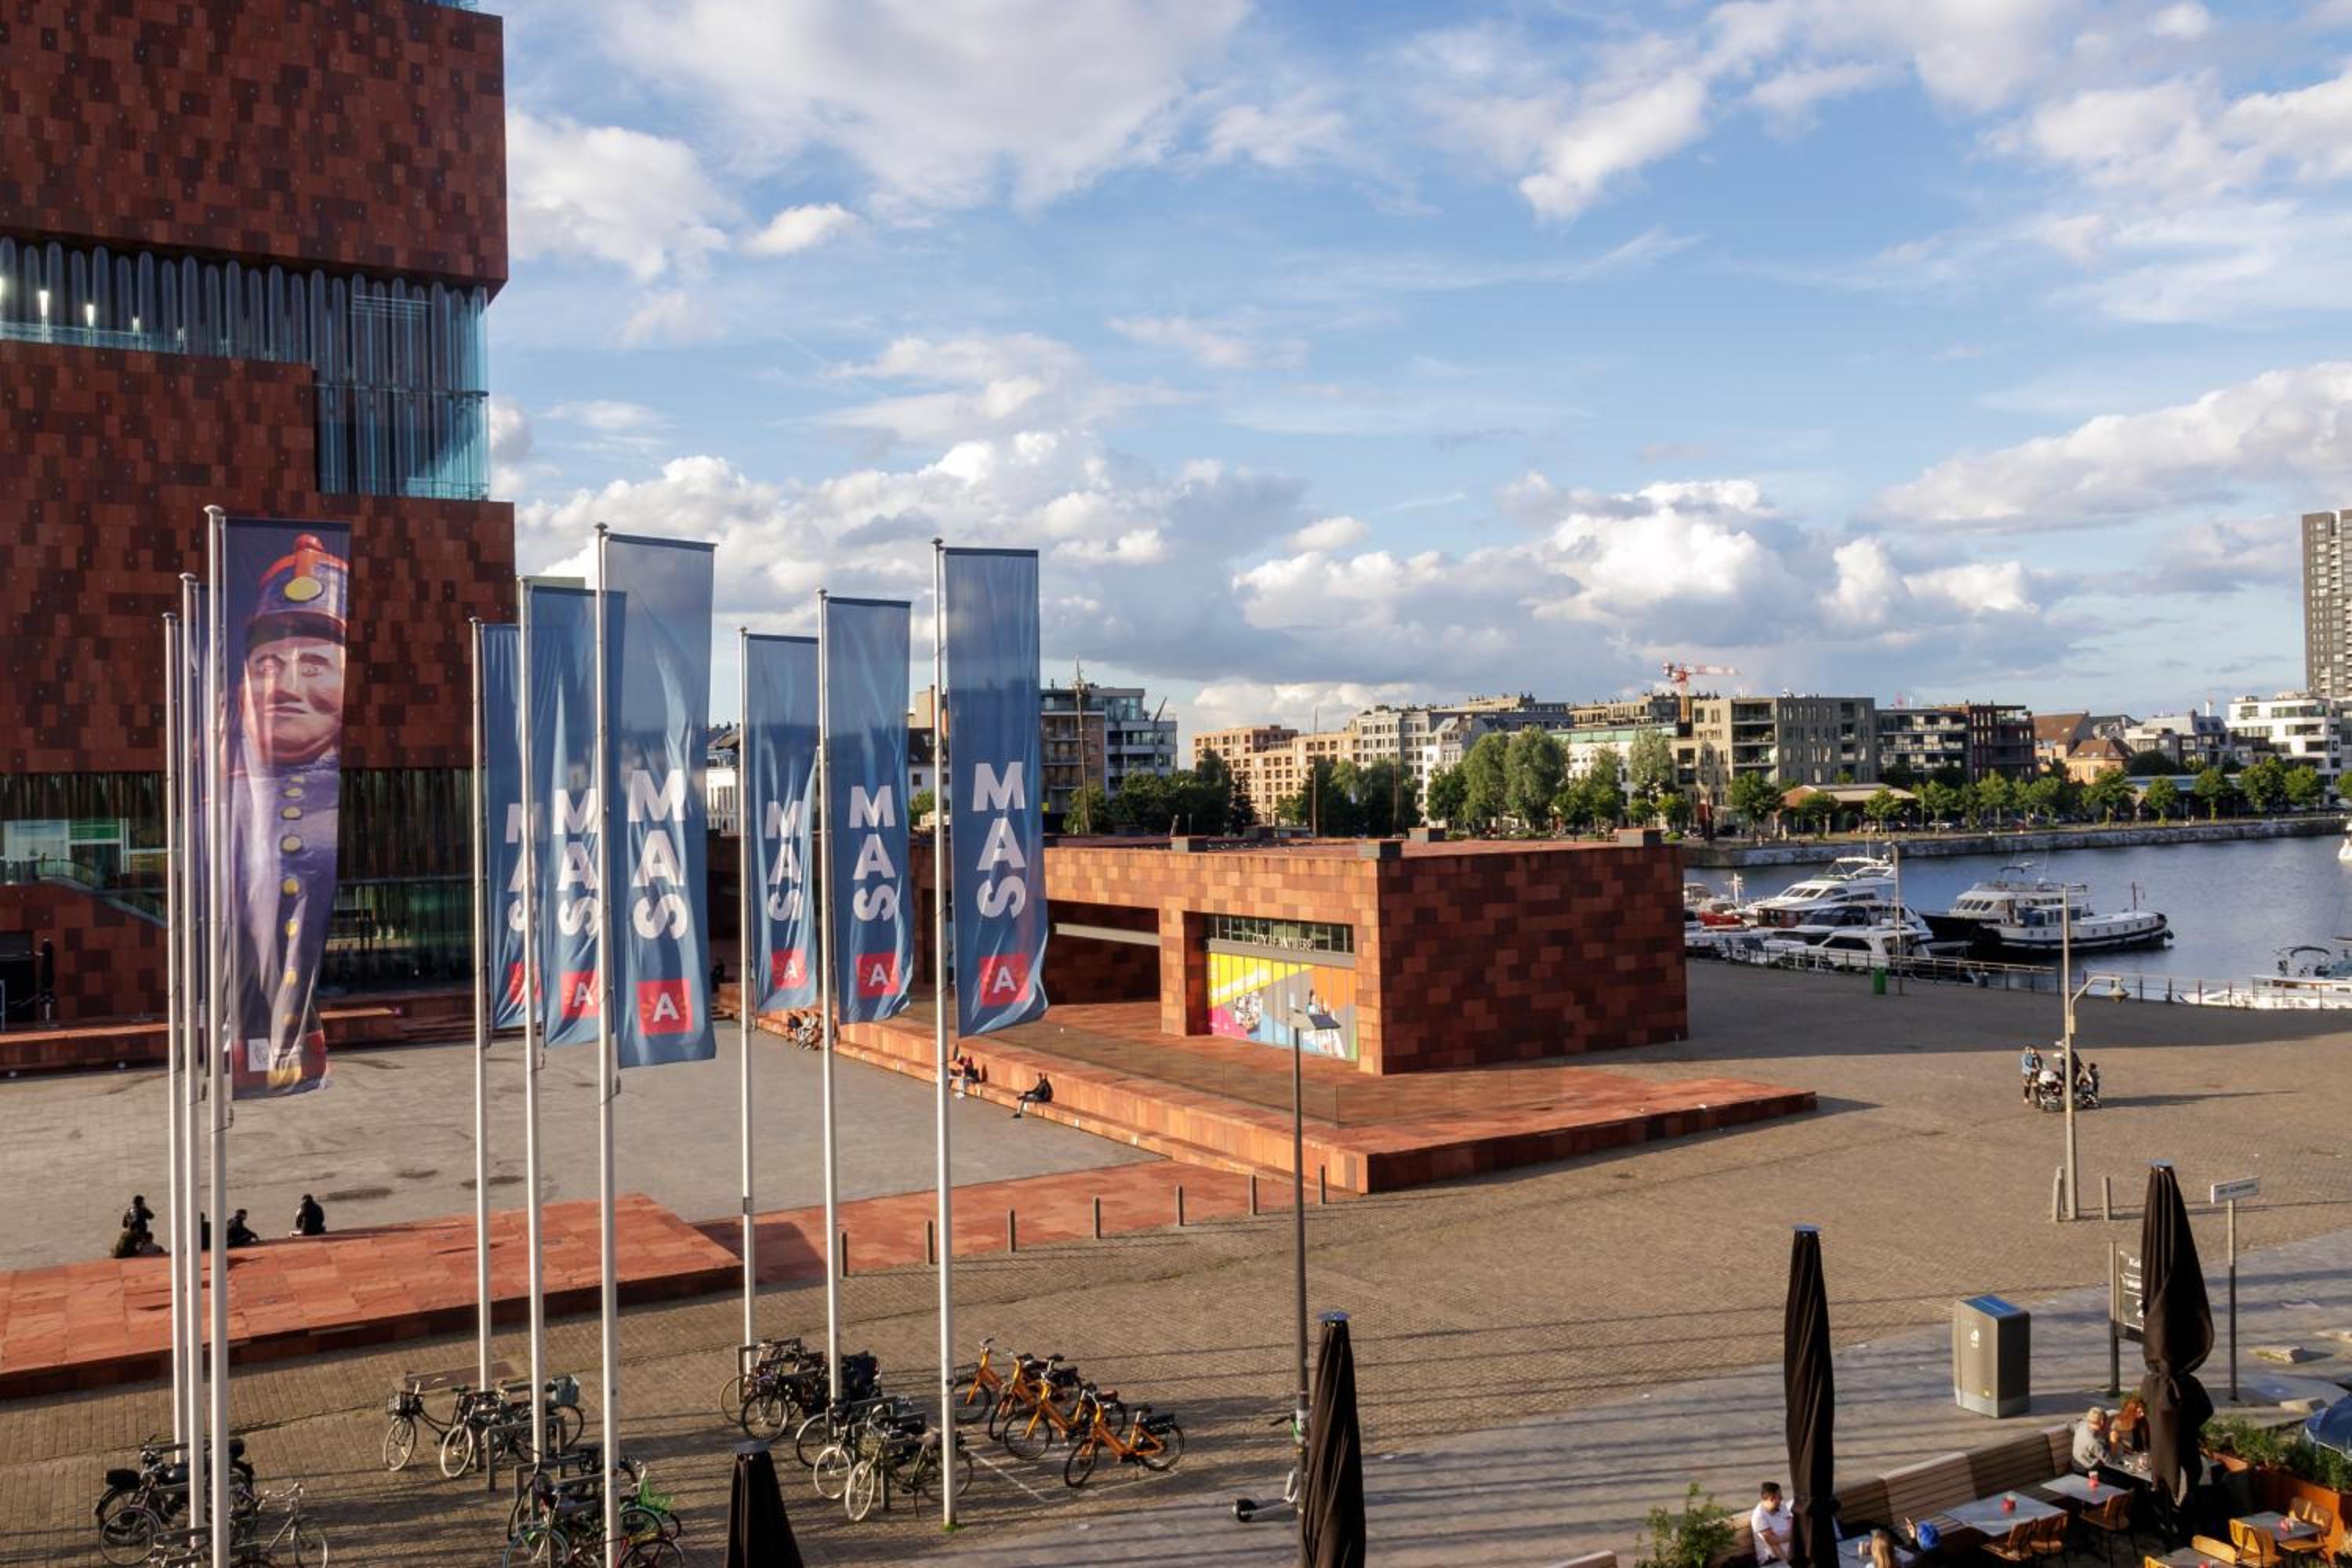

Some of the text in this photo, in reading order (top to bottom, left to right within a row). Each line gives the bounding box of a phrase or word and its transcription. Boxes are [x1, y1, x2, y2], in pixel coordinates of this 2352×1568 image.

[553, 788, 599, 936] MAS
[628, 769, 688, 940] MAS
[764, 800, 803, 922] MAS
[849, 785, 897, 922] MAS
[972, 761, 1027, 919] MAS
